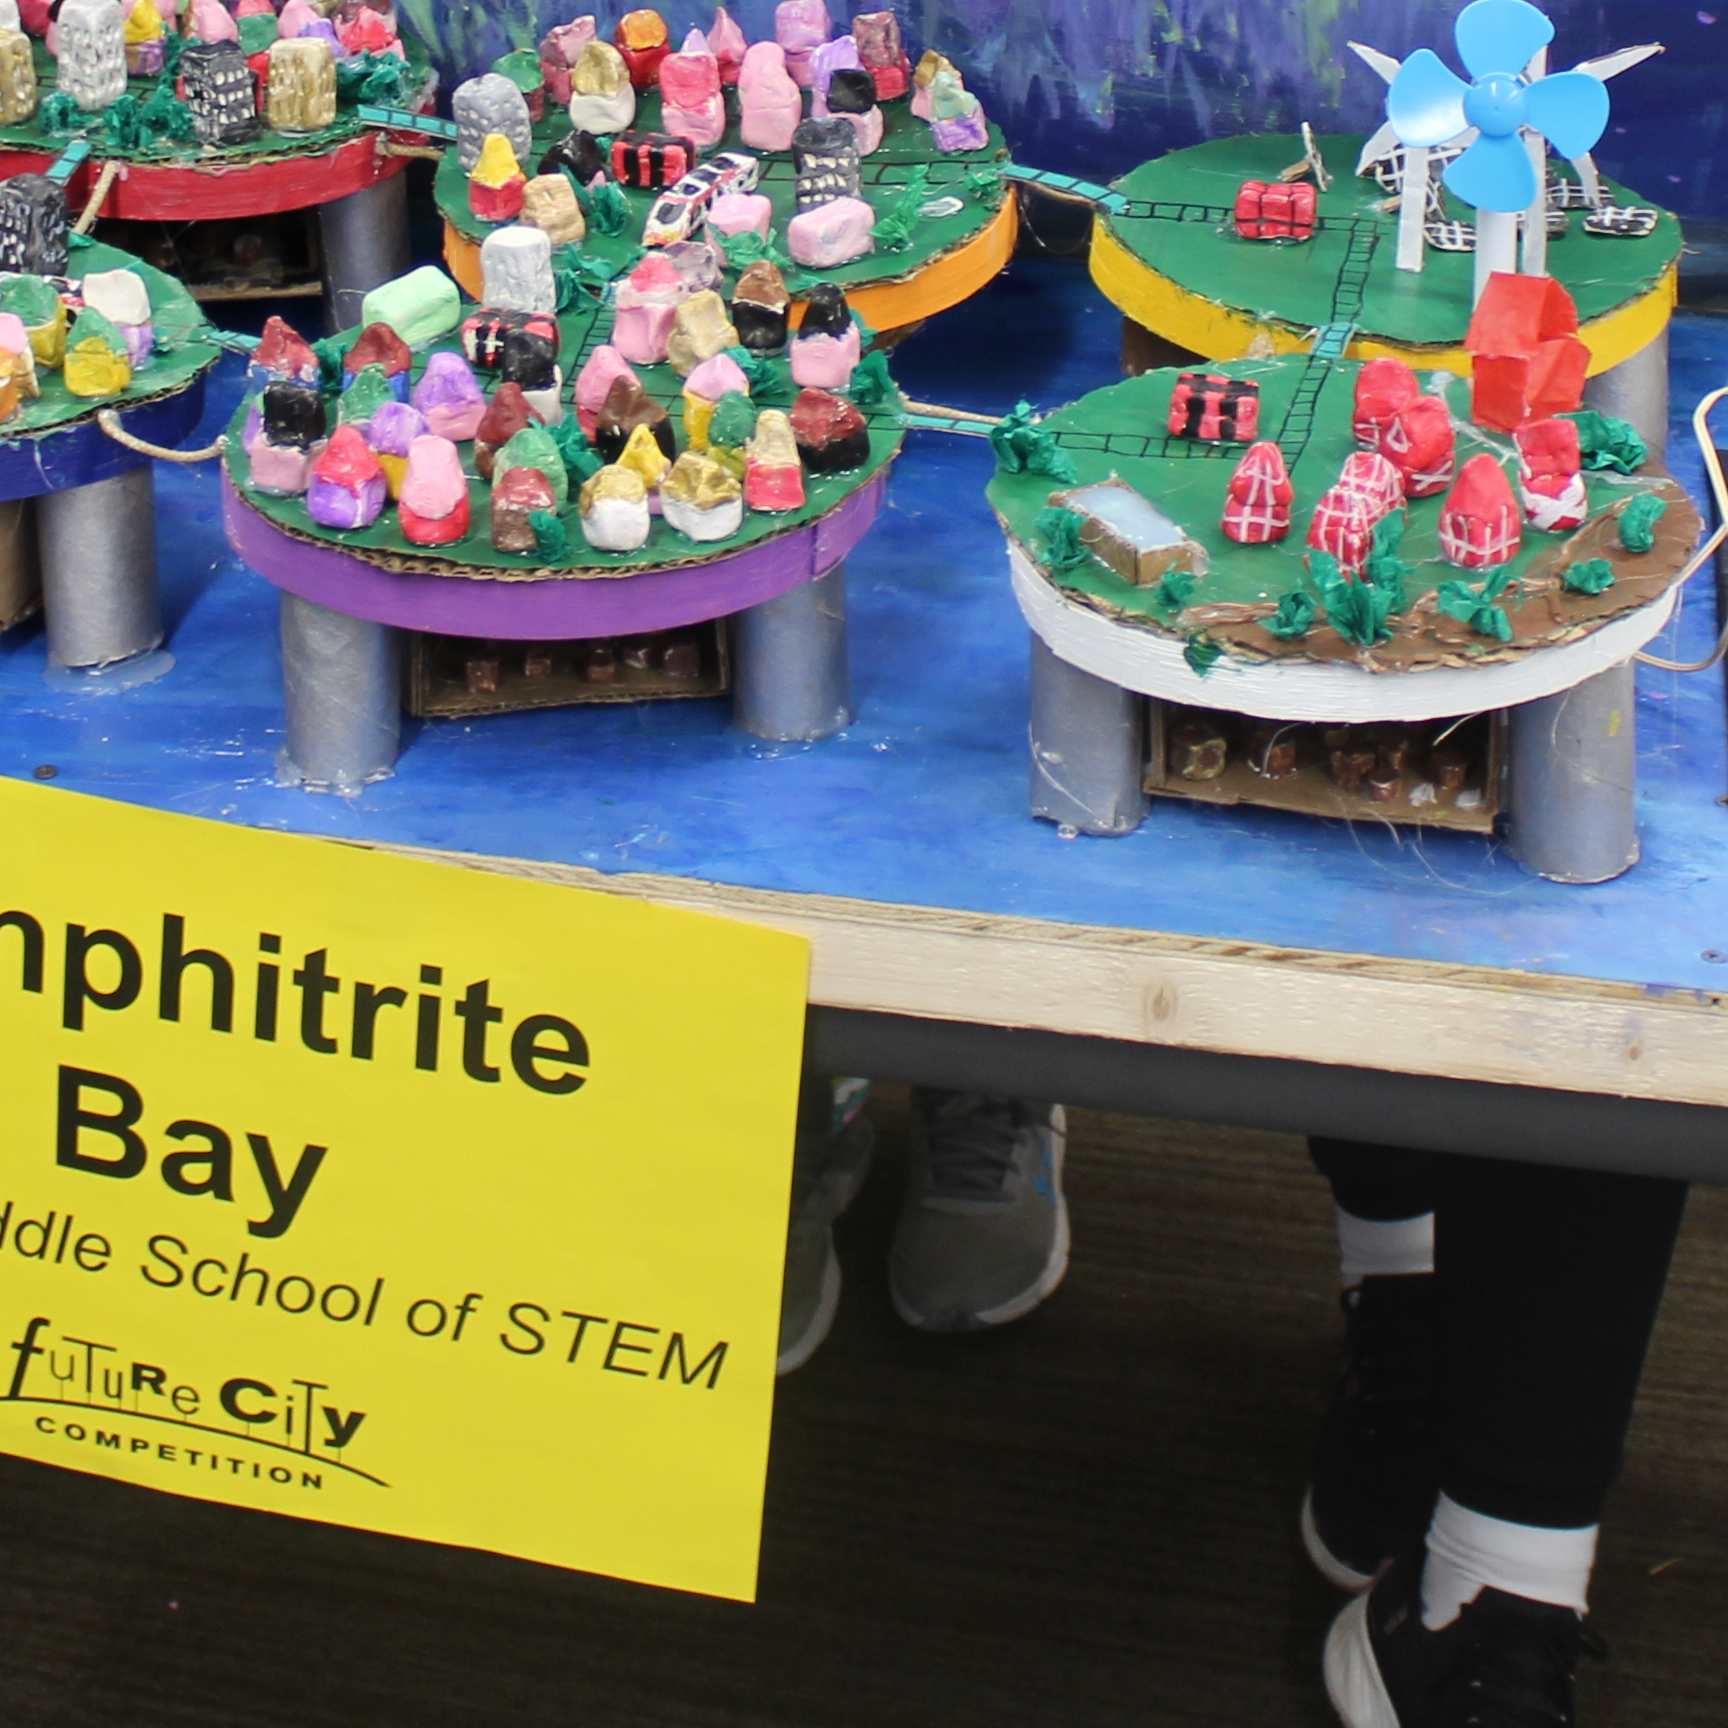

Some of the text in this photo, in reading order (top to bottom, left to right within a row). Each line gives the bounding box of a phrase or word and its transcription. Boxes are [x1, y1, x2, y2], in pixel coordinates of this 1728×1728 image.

[55, 1064, 329, 1240] Bay
[138, 1232, 385, 1330] School
[406, 1292, 482, 1343] of
[500, 1300, 732, 1393] STEM
[35, 1415, 323, 1490] COMPETITION
